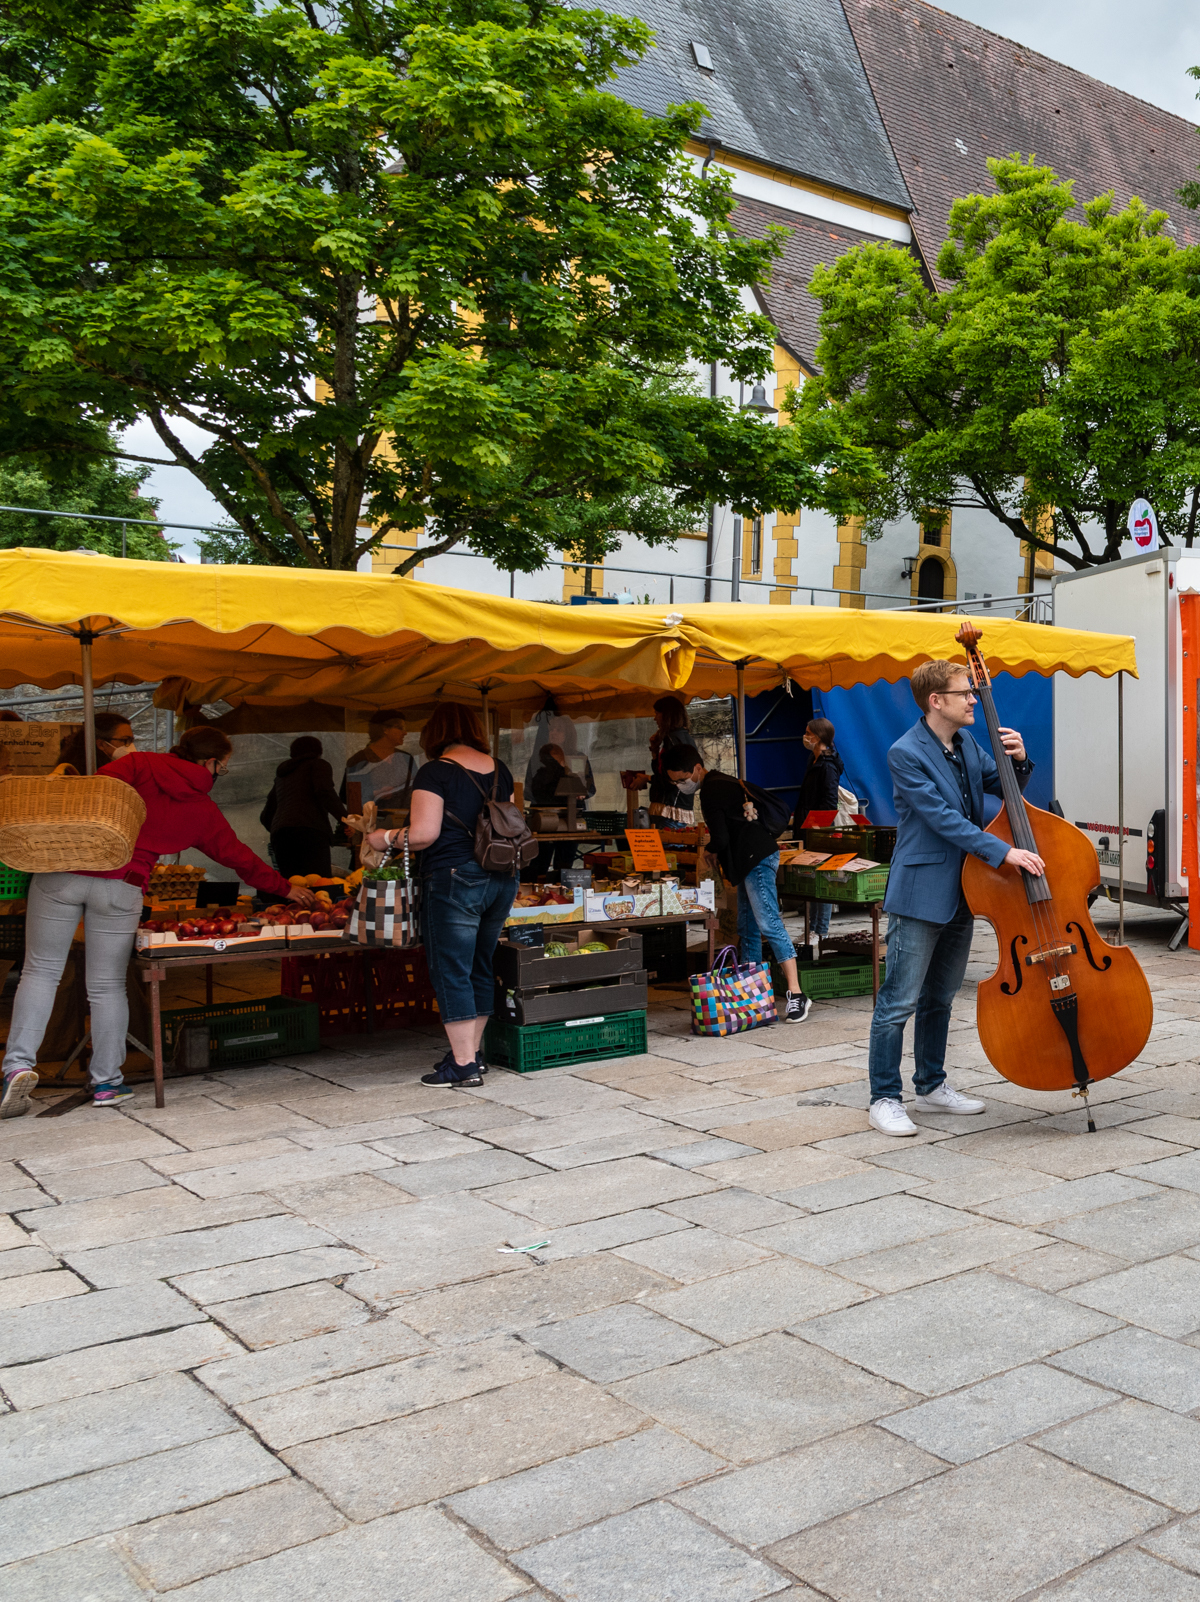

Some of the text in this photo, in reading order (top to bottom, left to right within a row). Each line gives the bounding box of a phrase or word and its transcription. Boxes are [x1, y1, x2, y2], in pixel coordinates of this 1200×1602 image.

[0, 724, 58, 738] che Eier
[0, 739, 45, 747] enhaltung
